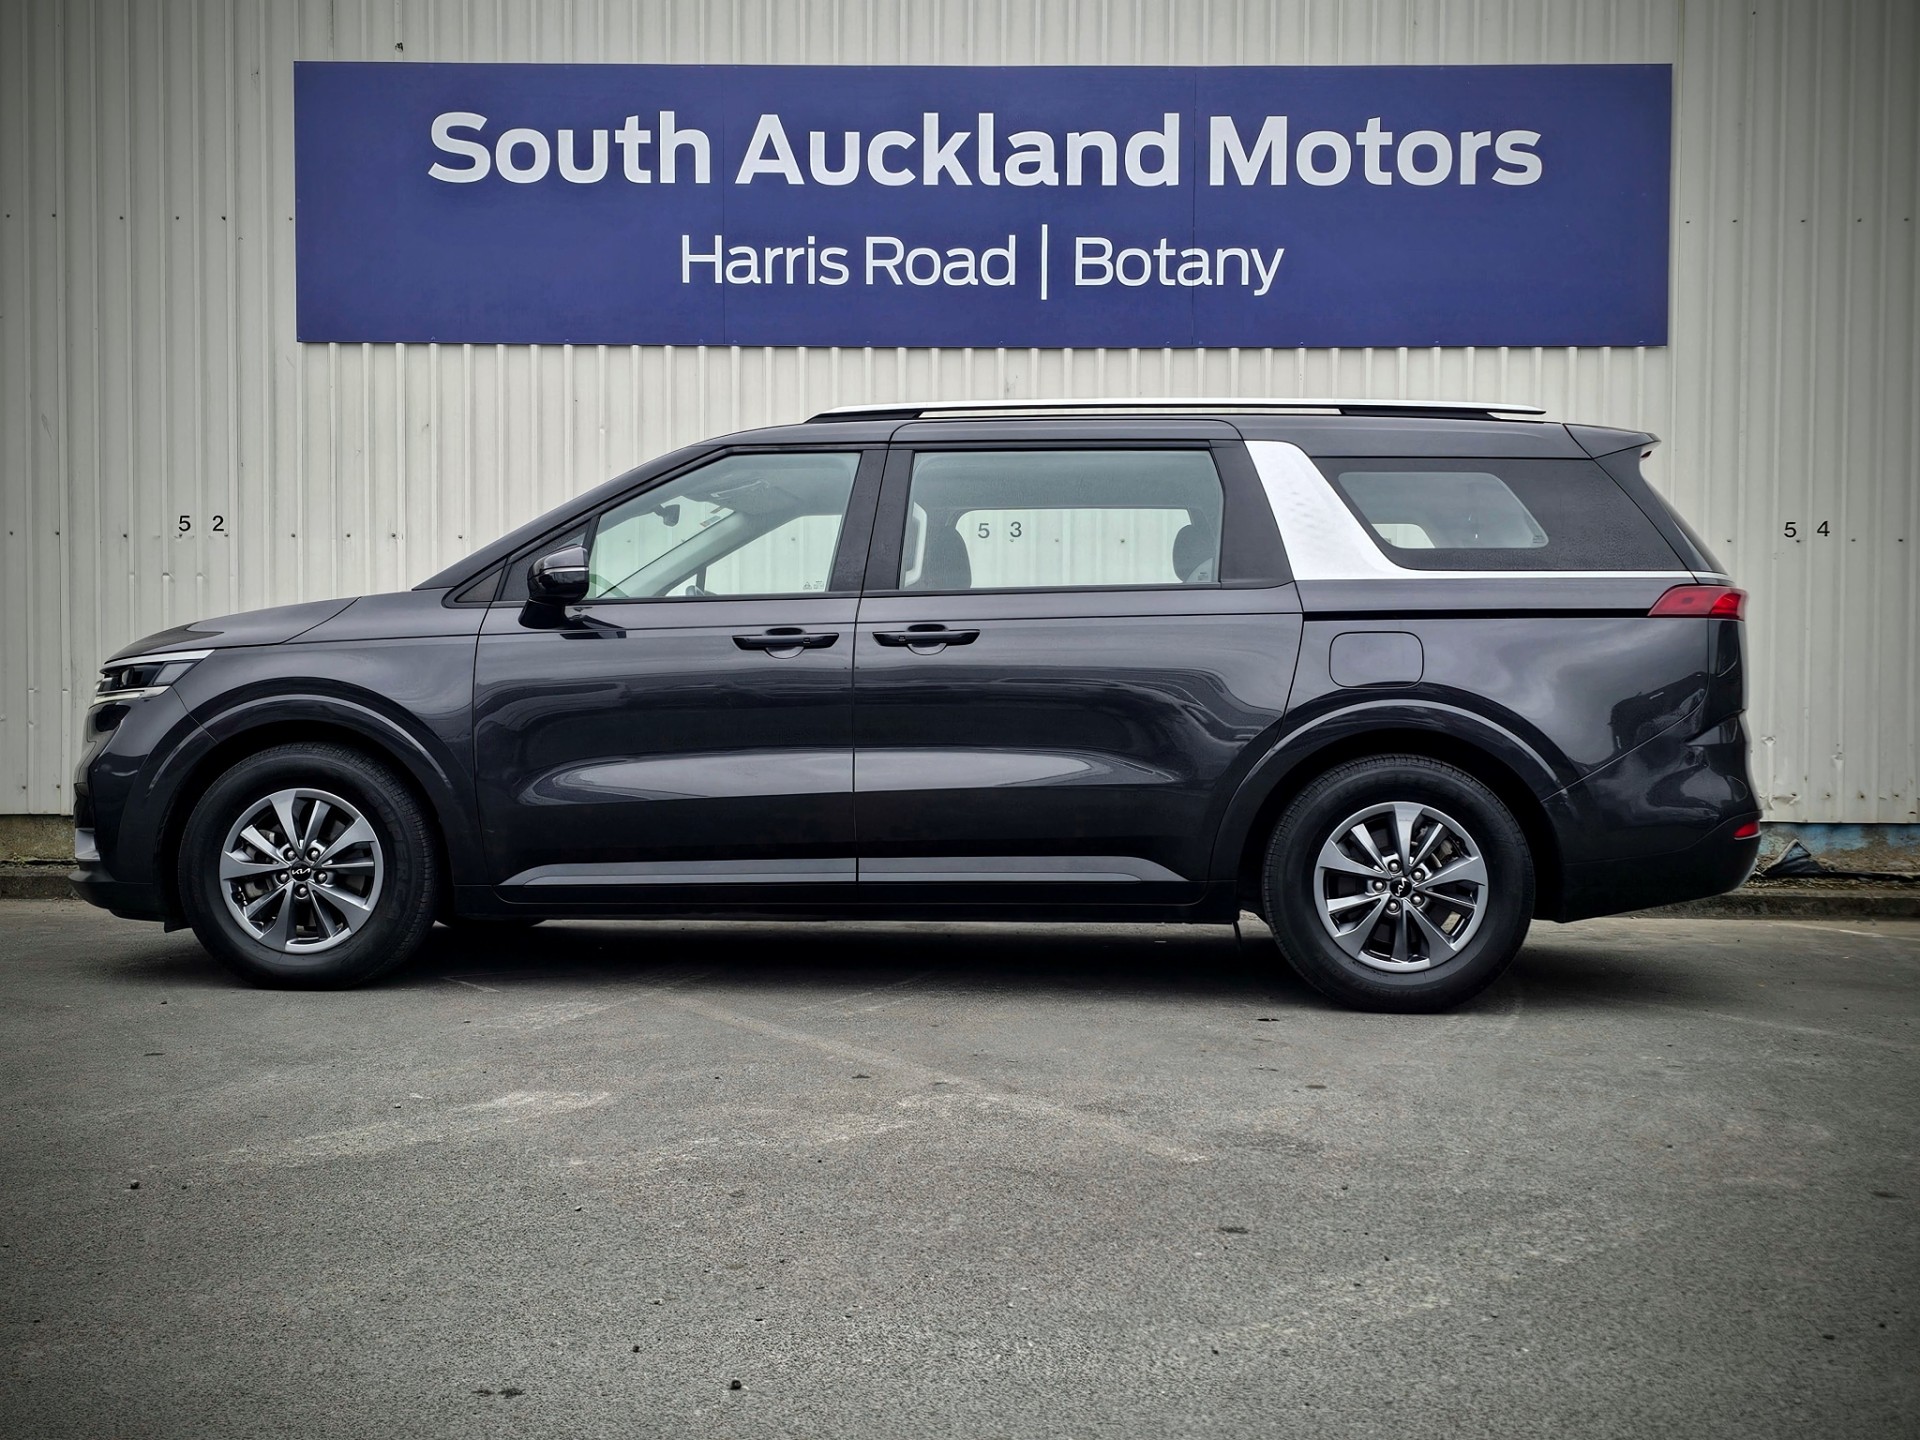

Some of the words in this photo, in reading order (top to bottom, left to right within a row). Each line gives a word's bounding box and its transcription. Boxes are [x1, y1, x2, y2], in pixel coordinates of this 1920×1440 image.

[427, 110, 711, 185] South
[734, 111, 1181, 187] Auckland
[1209, 114, 1543, 187] Motors
[680, 233, 851, 287] Harris
[864, 233, 1017, 288] Road
[1074, 235, 1285, 297] Botany
